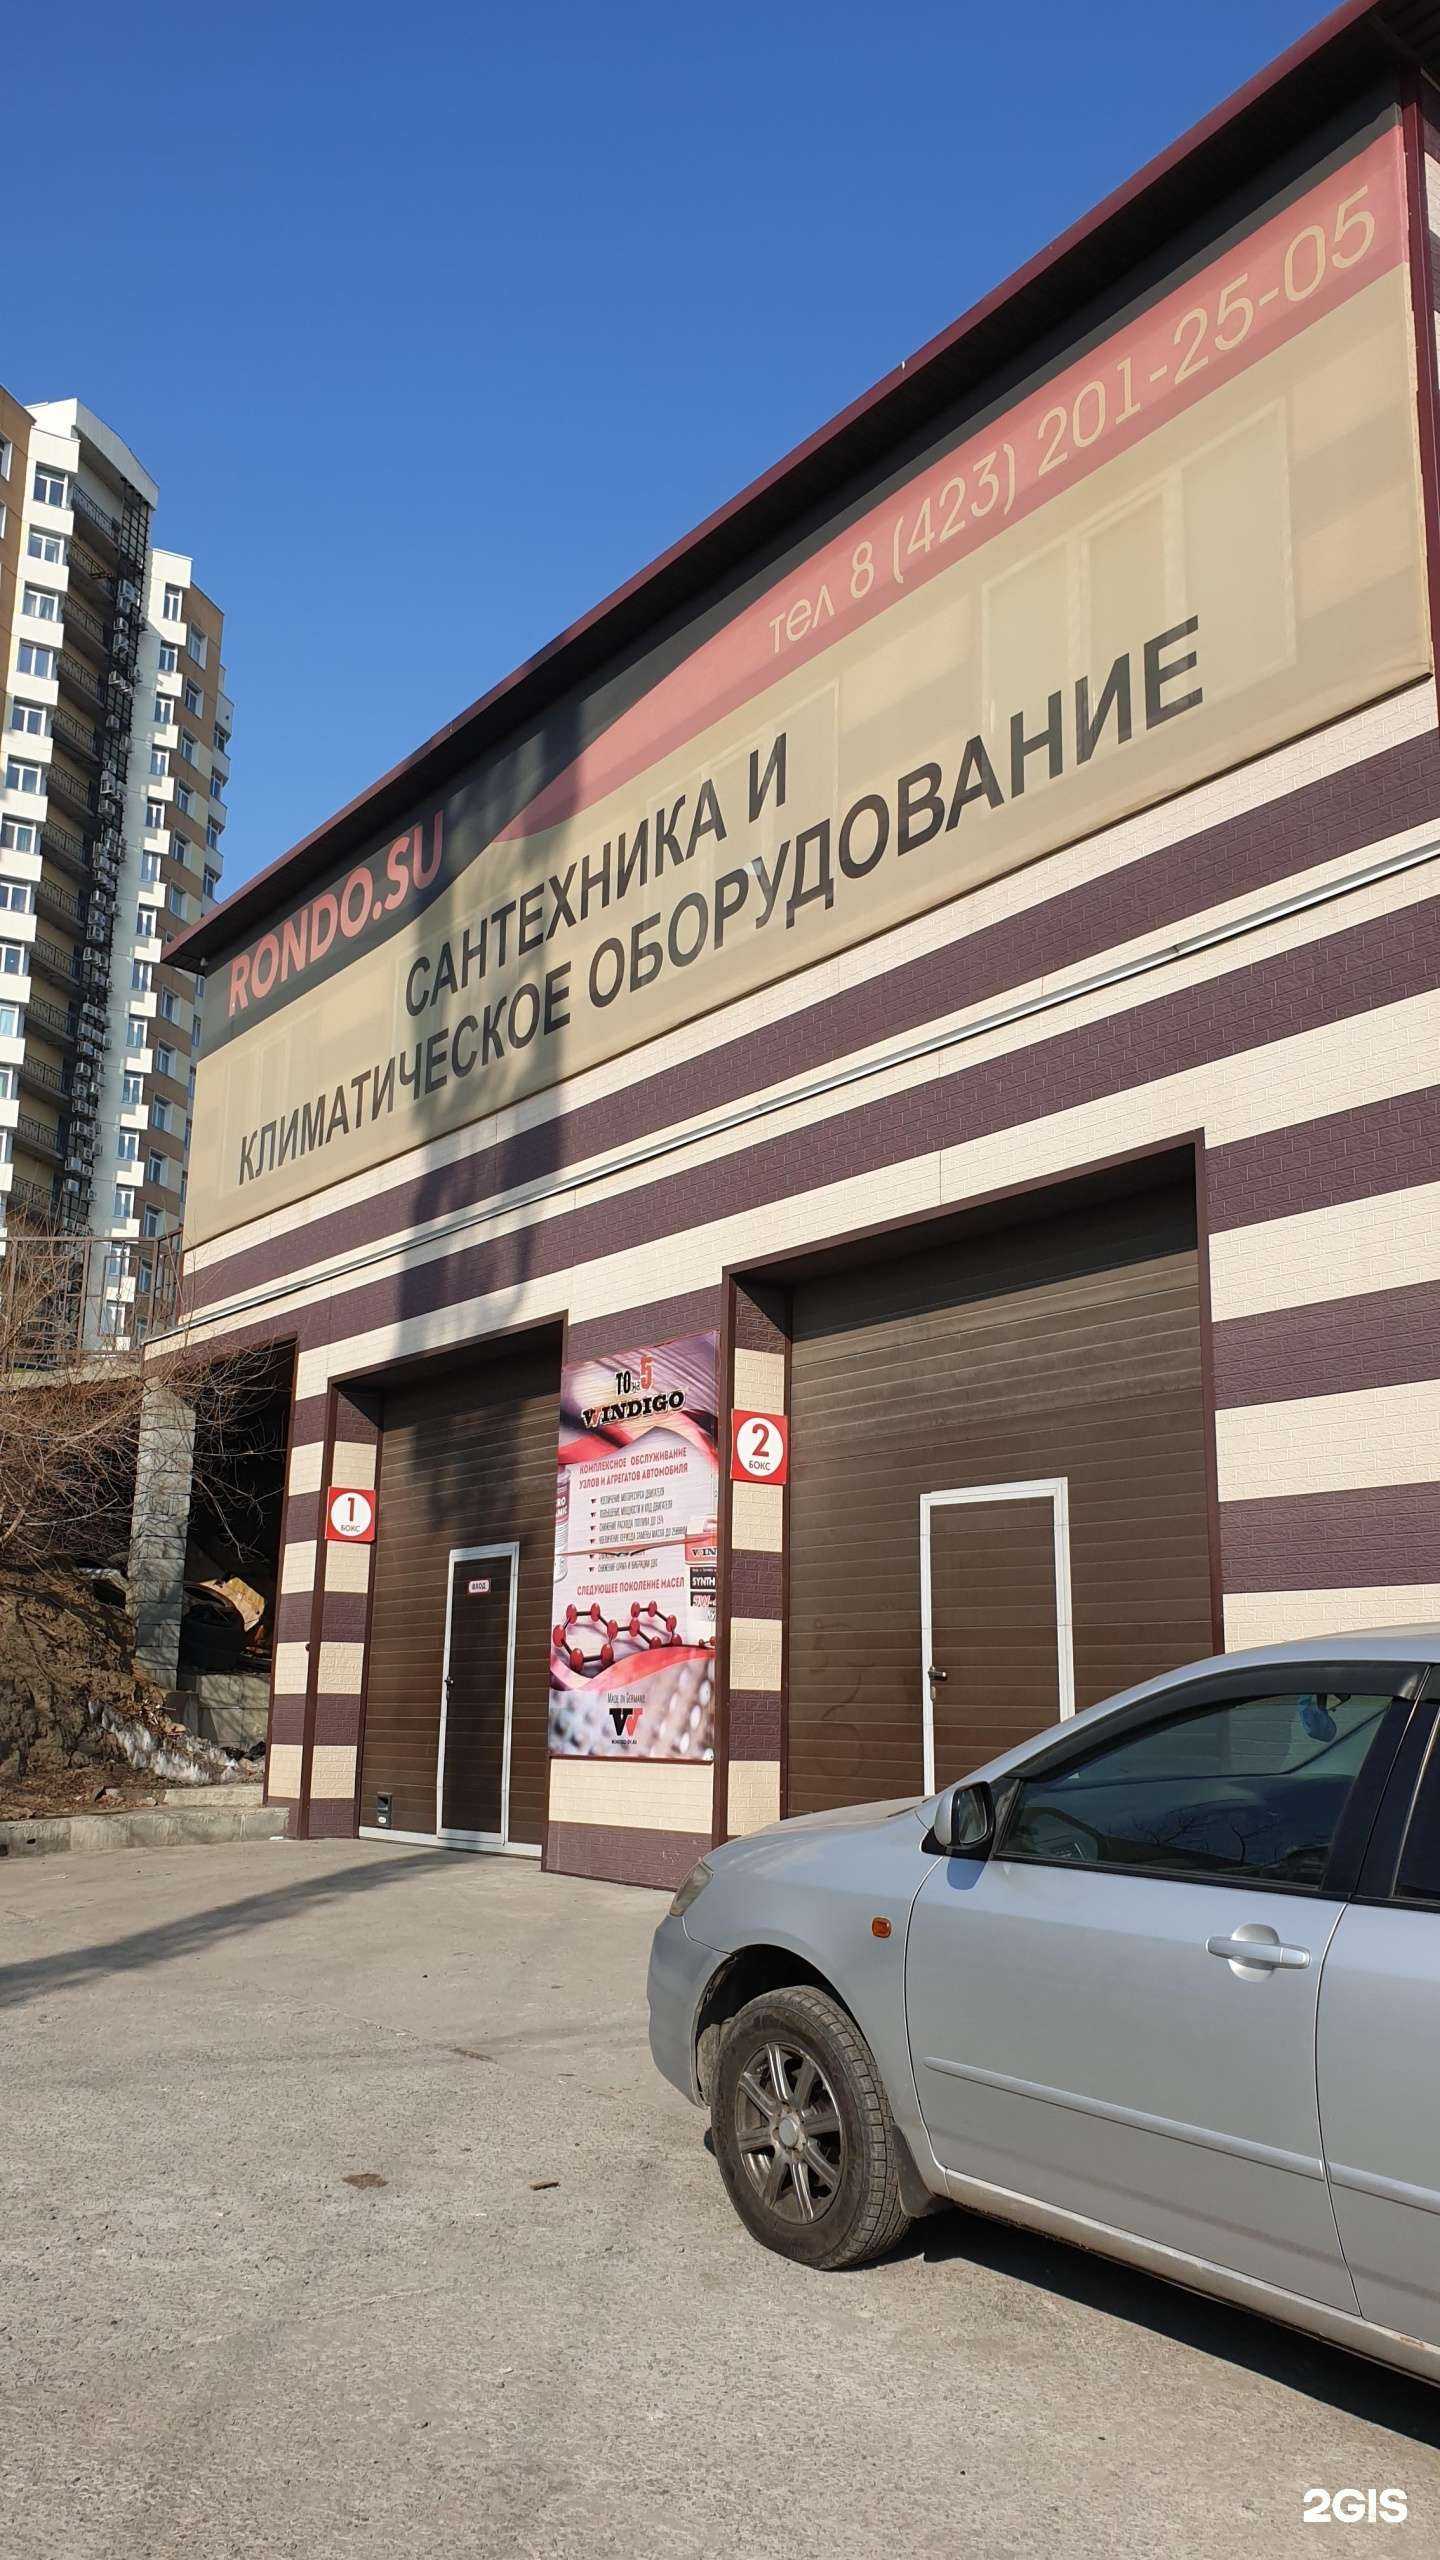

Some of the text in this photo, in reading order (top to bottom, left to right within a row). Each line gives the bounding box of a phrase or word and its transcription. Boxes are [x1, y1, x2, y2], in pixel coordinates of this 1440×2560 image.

[768, 185, 1377, 654] тел 8 (423) 201-25-05
[405, 732, 787, 1018] САНТЕХНИКА И
[228, 809, 444, 1018] RONDO.SU
[238, 614, 1204, 1186] КЛИМАТИЧЕСКОЕ ОБОРУДОВАНИЕ
[640, 1356, 654, 1390] 5
[752, 1423, 769, 1457] 2
[578, 1476, 599, 1489] УЗЛОВ
[606, 1470, 640, 1485] АГРЕГАТОВ
[642, 1462, 688, 1479] АВТОМОБИЛЯ
[579, 1447, 687, 1474] КОМПЛЕКСНОЕ ОБСЛУЖИВАНИЕ
[748, 1460, 771, 1471] БОКС
[347, 1496, 355, 1522] 1
[340, 1524, 360, 1533] БОКС
[577, 1576, 685, 1596] СЛЕДУЮЩЕЕ ПОКОЛЕНИЕ МАСЕЛ
